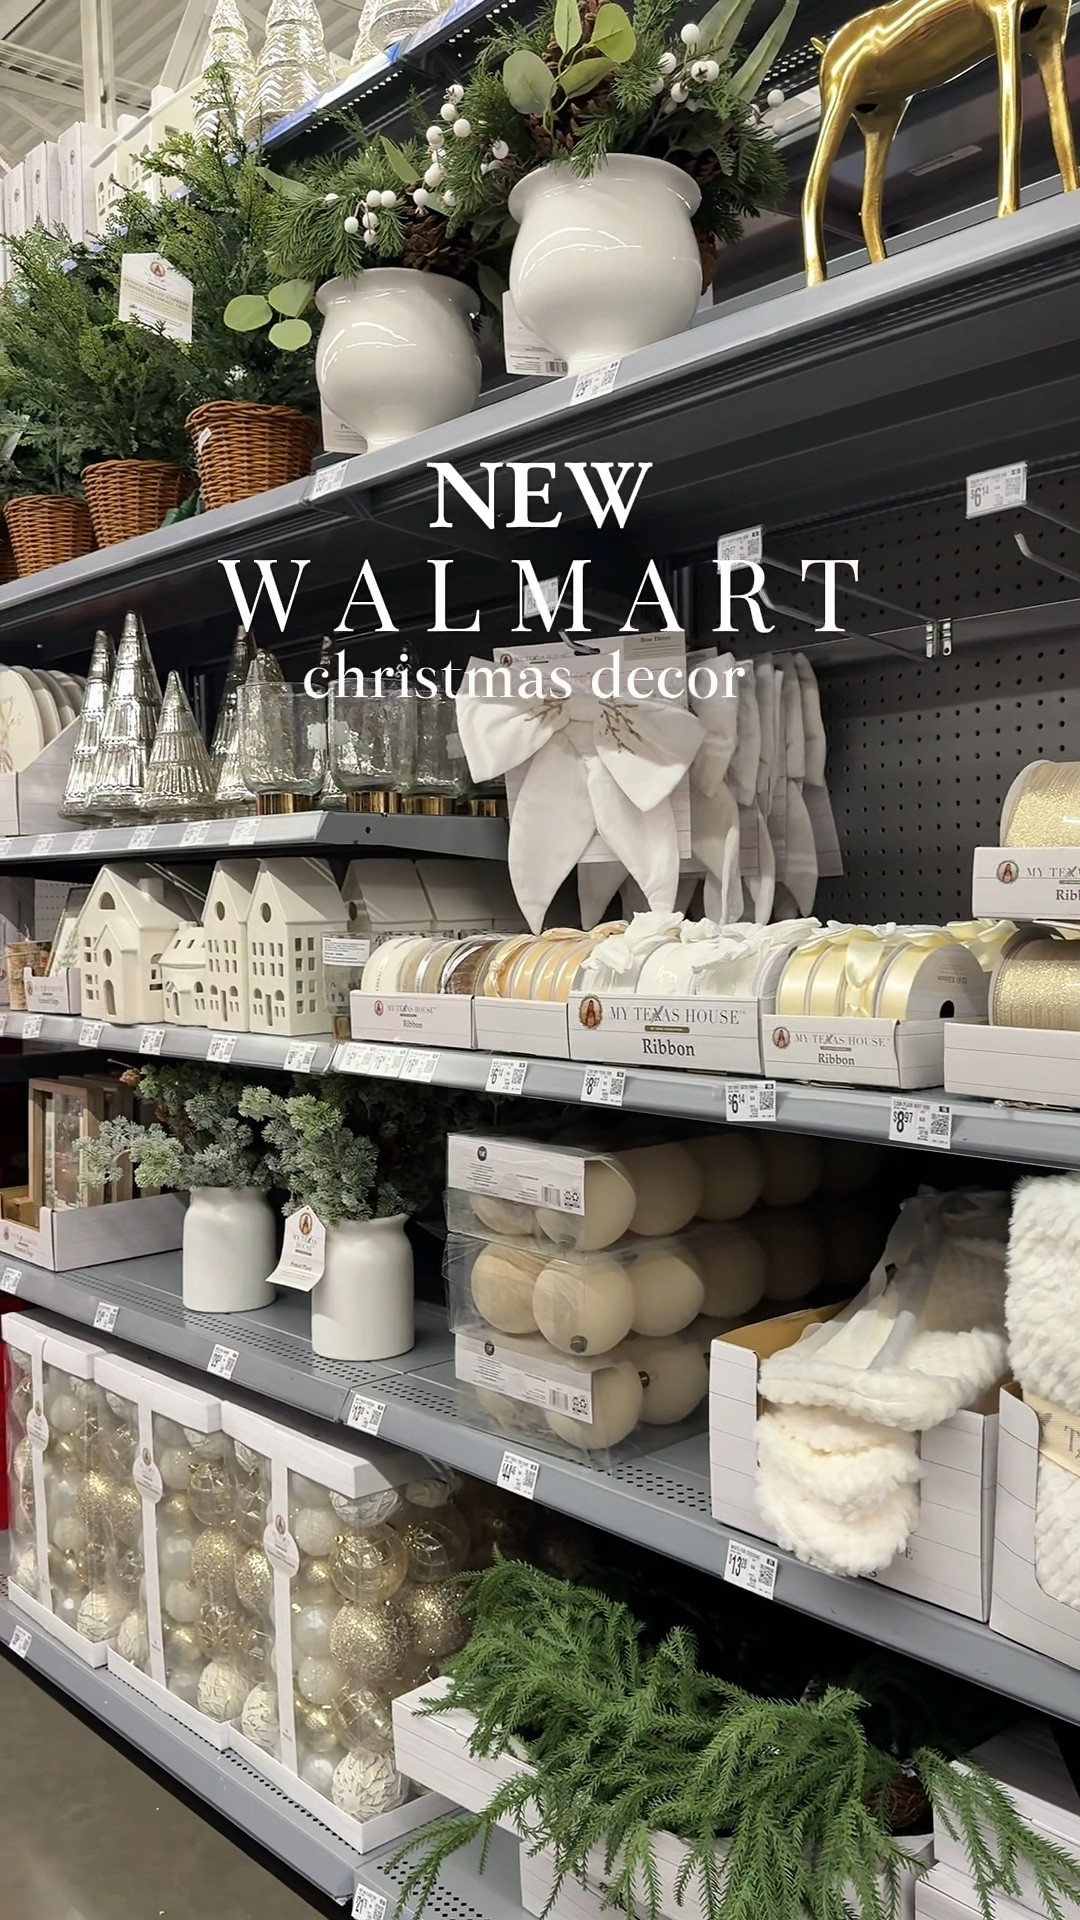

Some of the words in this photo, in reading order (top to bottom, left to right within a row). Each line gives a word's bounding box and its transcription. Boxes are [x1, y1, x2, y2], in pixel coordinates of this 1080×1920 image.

[1027, 867, 1043, 877] MY
[1049, 865, 1080, 878] TEX
[610, 1006, 628, 1021] MY
[633, 1005, 680, 1023] TEXAS
[685, 1008, 740, 1025] HOUSE
[795, 1033, 809, 1044] MY
[812, 1034, 845, 1045] TEXAS
[848, 1036, 886, 1047] HOUSE
[641, 1038, 695, 1057] Ribbon
[818, 1052, 855, 1066] Ribbon
